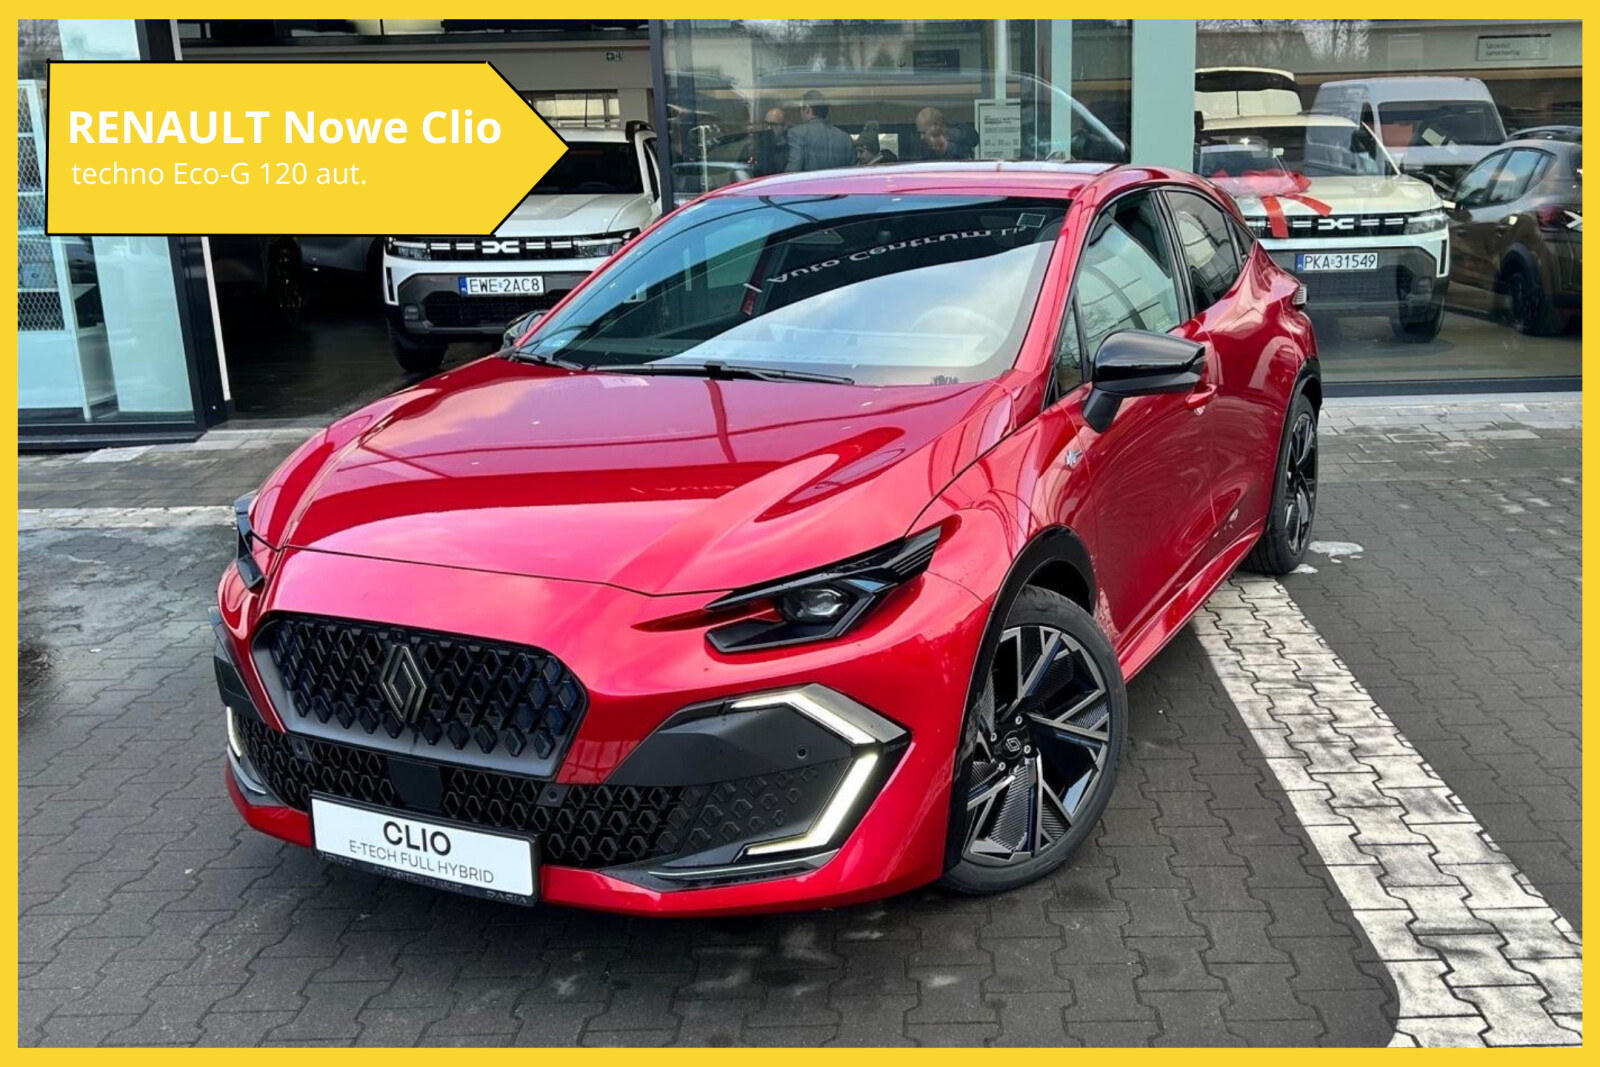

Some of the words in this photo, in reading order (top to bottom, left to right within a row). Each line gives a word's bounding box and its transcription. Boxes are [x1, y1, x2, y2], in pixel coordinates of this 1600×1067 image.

[1304, 255, 1330, 269] PKA
[1334, 254, 1376, 269] 31549
[469, 278, 498, 293] EWE
[502, 277, 540, 292] 2AC8
[383, 820, 452, 857] CLIO
[349, 839, 397, 864] E-TECH
[400, 852, 436, 873] FULL
[437, 862, 494, 884] HYBRID
